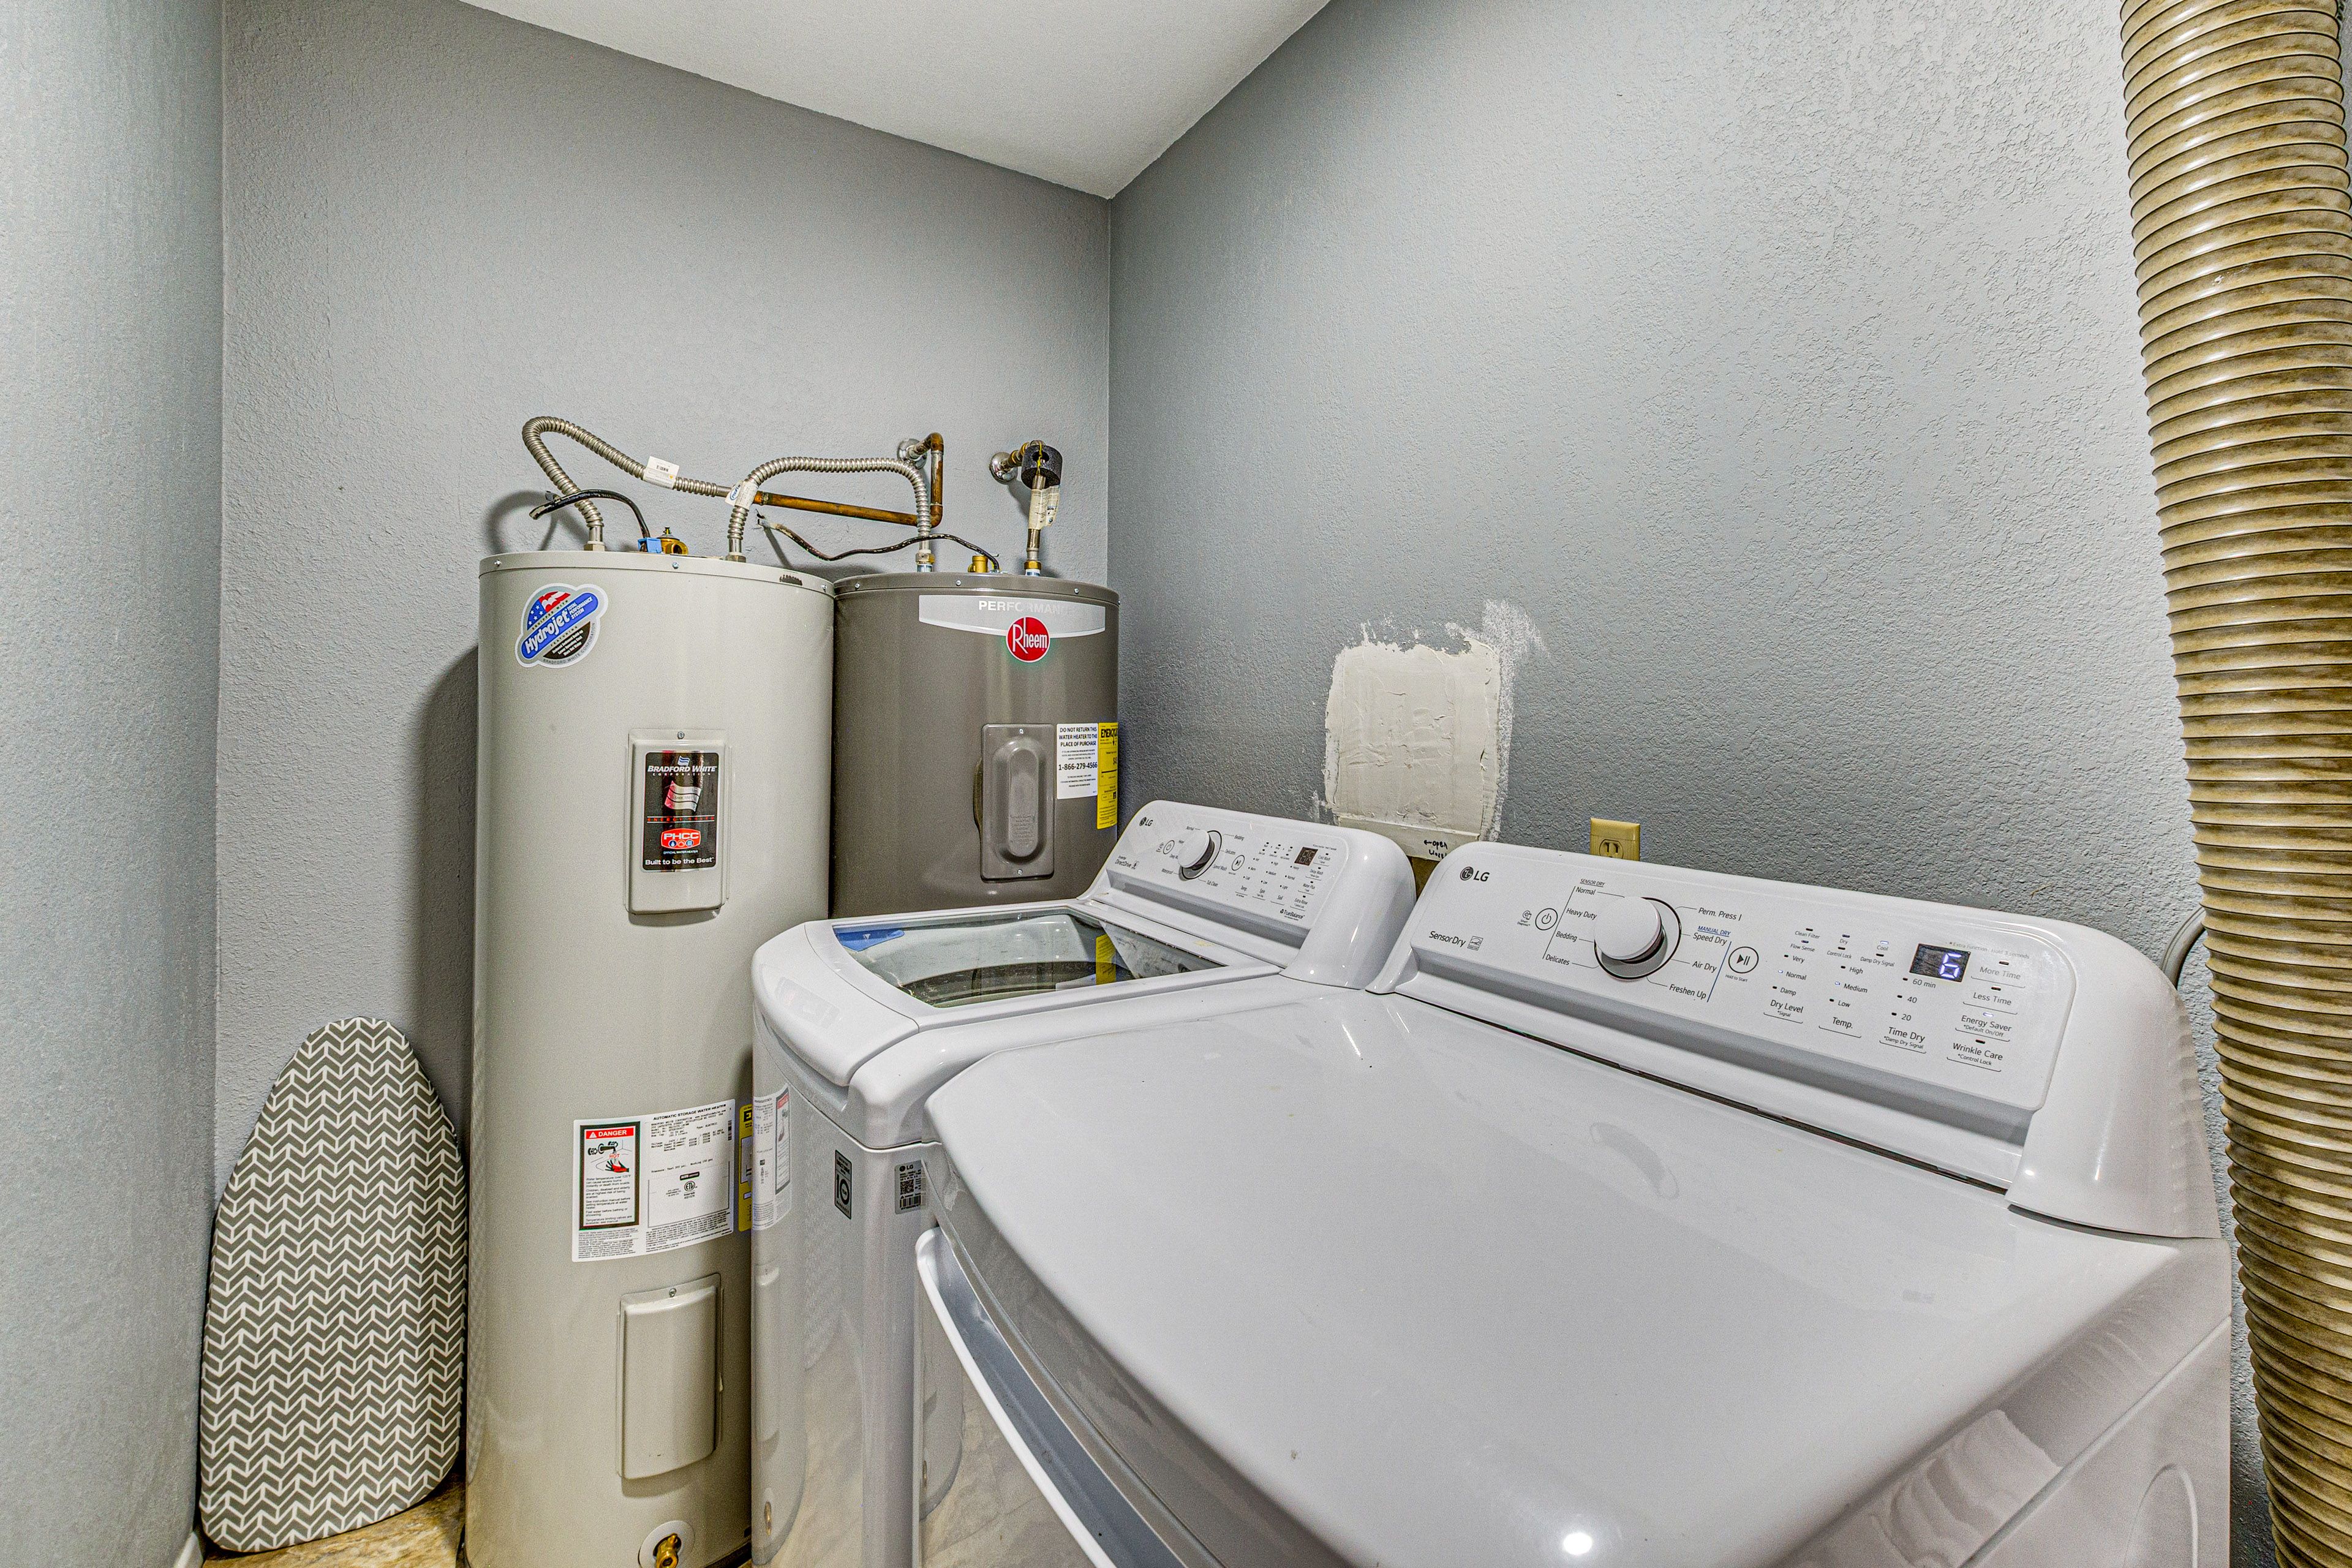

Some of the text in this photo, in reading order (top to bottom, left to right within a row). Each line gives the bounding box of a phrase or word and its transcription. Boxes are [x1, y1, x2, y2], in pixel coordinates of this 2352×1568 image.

[569, 596, 593, 615] PERFORMANCE
[571, 608, 585, 619] SYSTEM
[524, 610, 570, 654] Hydrojet
[1012, 617, 1047, 654] Rheem
[568, 652, 580, 662] WHITE
[581, 622, 595, 653] CORPORATION
[1058, 762, 1097, 771] 1-866-279-4566
[1433, 840, 1448, 850] open
[1473, 870, 1490, 881] LG
[1284, 910, 1303, 919] TrueBalance
[1566, 908, 1597, 920] Heavy Duty
[1698, 908, 1736, 920] Perm. Press
[1698, 925, 1719, 935] MANUAL
[1556, 931, 1577, 942] Bedding
[1693, 932, 1727, 946] Speed Dry
[1546, 954, 1570, 965] Delicates
[1704, 963, 1717, 973] Dry
[1849, 967, 1863, 975] High
[1939, 952, 1962, 979] 6
[1980, 967, 1999, 975] More
[1786, 971, 1807, 980] Normal
[1669, 984, 1706, 1000] Freshen Up
[1780, 987, 1796, 997] Damp
[1844, 983, 1868, 993] Medium
[1973, 992, 2012, 1005] Less Time
[1770, 1000, 1804, 1013] Dry Level
[1833, 1017, 1853, 1029] Temp.
[1961, 1016, 2012, 1031] Energy Saver
[1888, 1027, 1925, 1043] Time Dry
[1986, 1029, 2004, 1038] On/Off
[1909, 1041, 1924, 1050] Signal
[1953, 1042, 2003, 1060] Wrinkle Care
